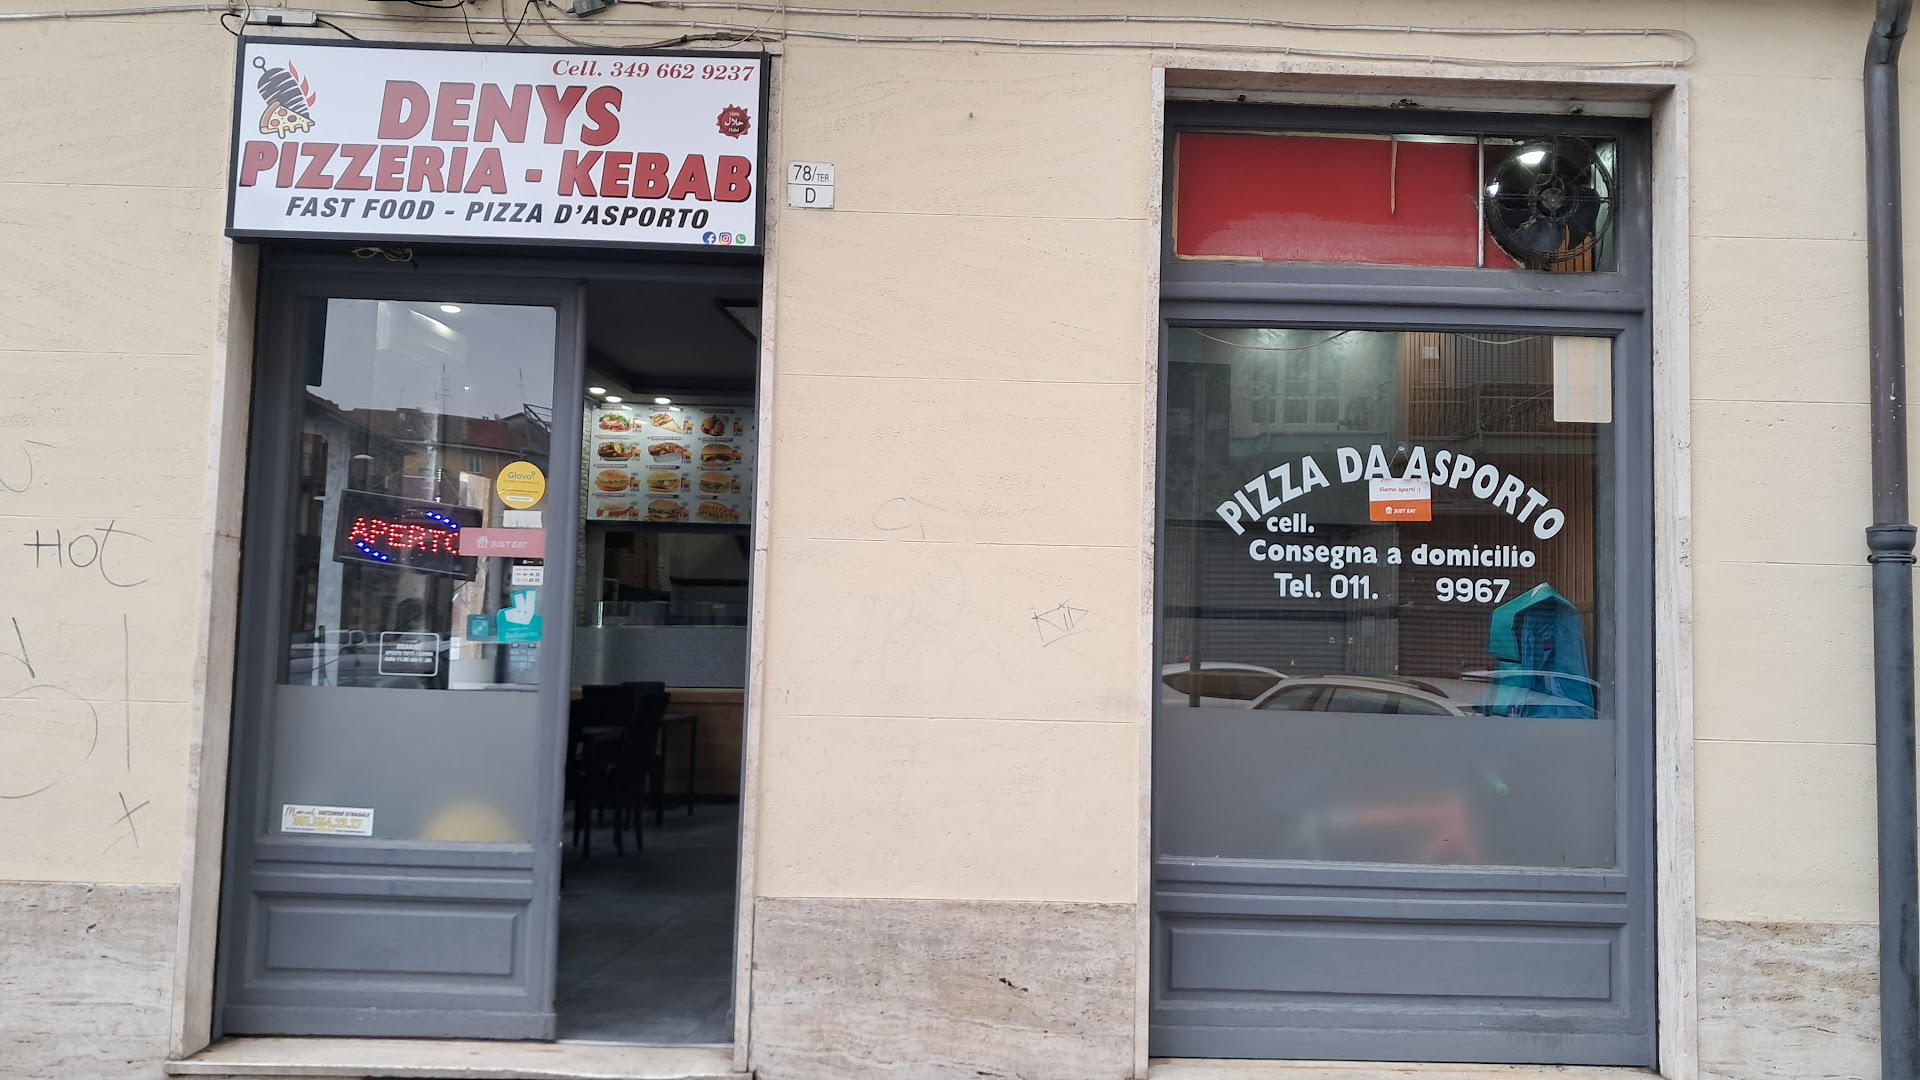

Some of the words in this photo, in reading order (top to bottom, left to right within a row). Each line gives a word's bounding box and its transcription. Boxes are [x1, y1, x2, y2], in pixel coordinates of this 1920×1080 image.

[552, 59, 602, 77] Cell.
[610, 61, 650, 78] 349
[656, 63, 696, 80] 662
[701, 64, 755, 82] 9237
[377, 80, 623, 146] DENYS
[239, 140, 508, 195] PIZZERIA
[524, 167, 544, 183] -
[557, 150, 752, 203] KEBAB
[805, 187, 816, 204] D
[285, 196, 356, 218] FAST
[362, 198, 435, 221] FOOD
[464, 201, 544, 224] PIZZA
[553, 204, 710, 229] D'ASPORTO
[508, 471, 533, 480] Glovo
[1215, 455, 1330, 537] PIZZA
[1336, 444, 1392, 484] DA
[1403, 445, 1566, 541] ASPORTO
[1265, 512, 1315, 534] cell.
[490, 540, 511, 548] JUST
[511, 540, 529, 548] EAT
[1249, 538, 1378, 570] Consegna
[1387, 549, 1402, 565] a
[1411, 543, 1536, 569] domicilio
[1273, 572, 1321, 599] Tel.
[1330, 573, 1379, 600] 011.
[1435, 577, 1511, 603] 9967
